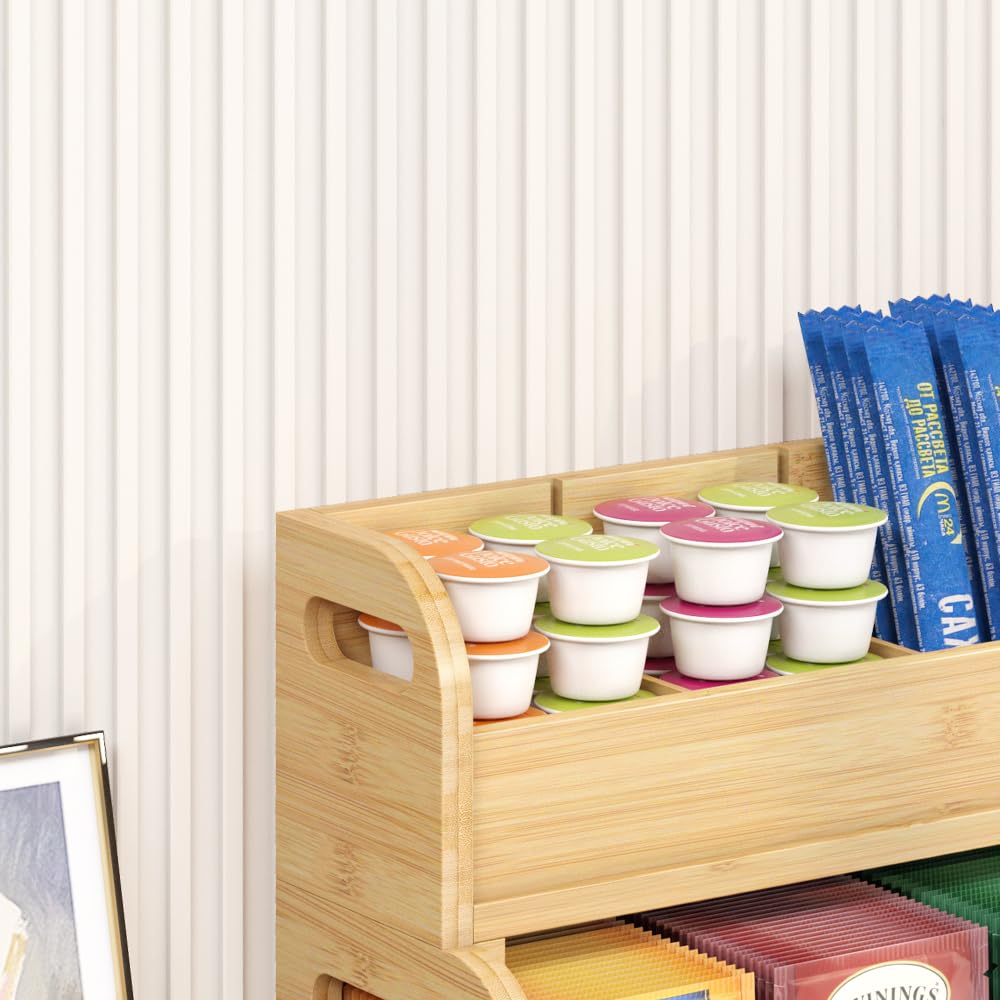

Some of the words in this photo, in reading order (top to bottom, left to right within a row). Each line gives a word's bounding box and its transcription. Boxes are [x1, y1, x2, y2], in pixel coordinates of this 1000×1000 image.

[917, 383, 934, 402] ОТ
[904, 399, 923, 415] ДО
[920, 404, 948, 473] РАССВЕТА
[912, 419, 938, 478] РАССВЕТА
[942, 519, 954, 535] 24
